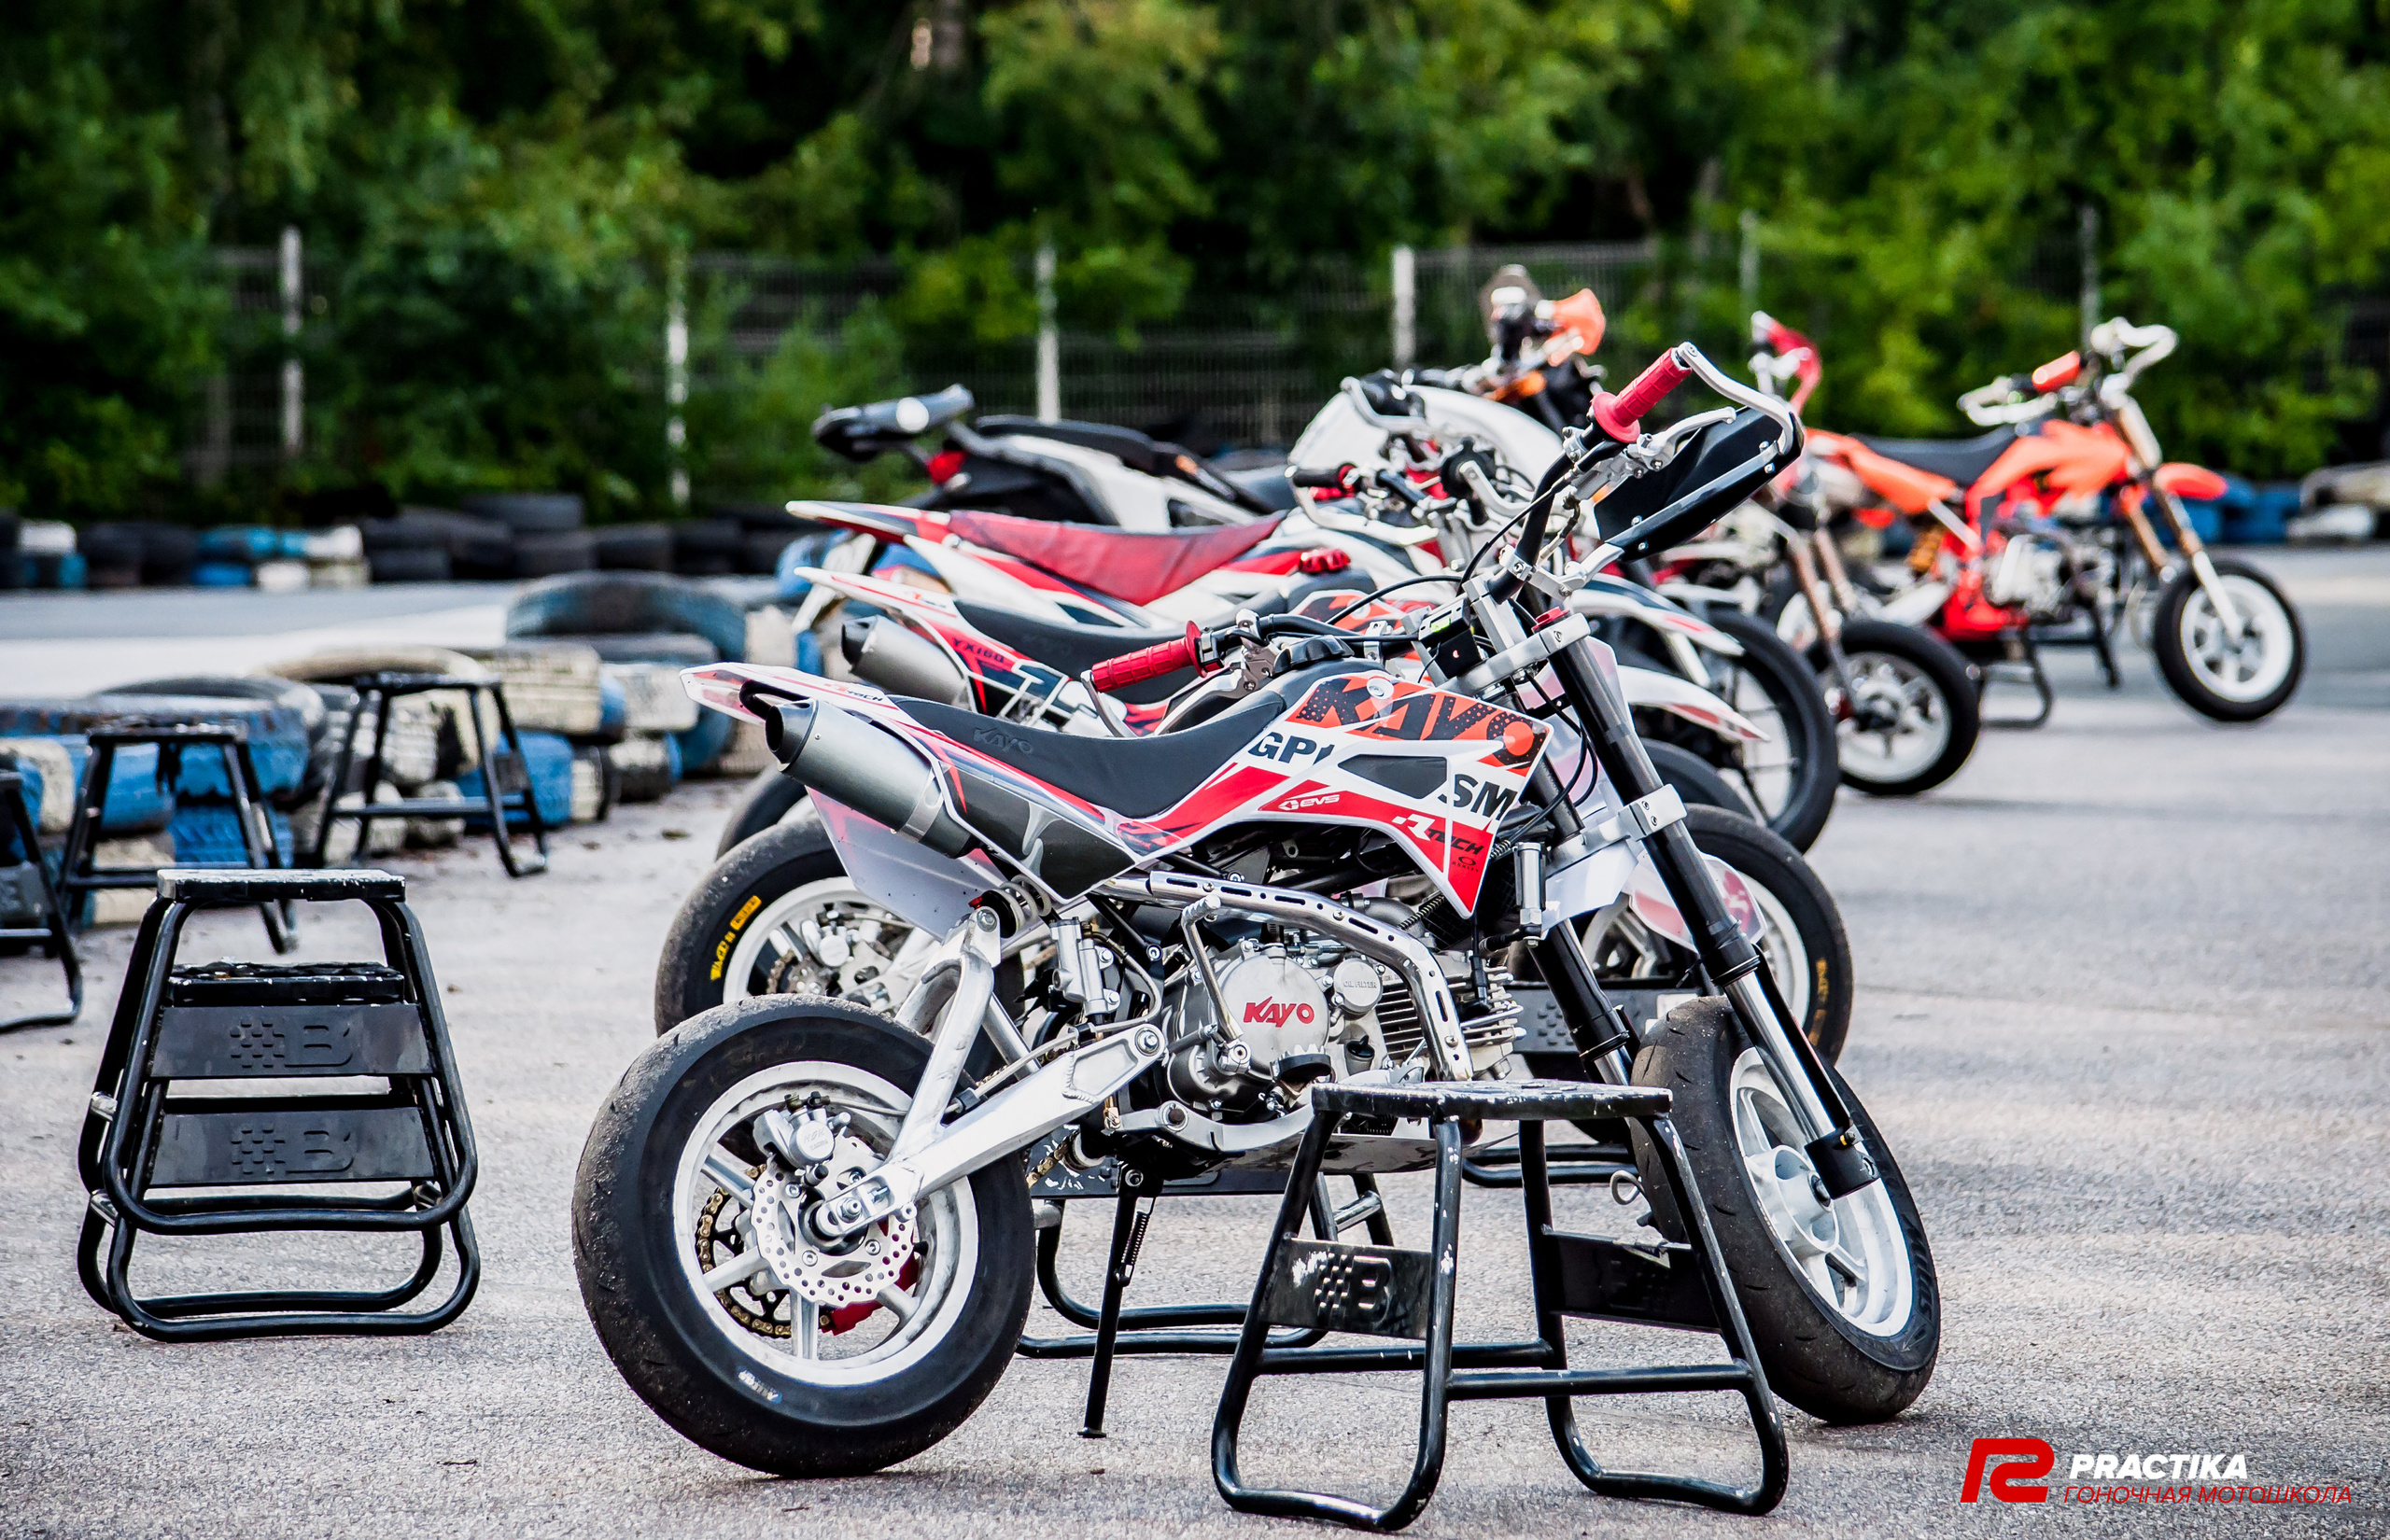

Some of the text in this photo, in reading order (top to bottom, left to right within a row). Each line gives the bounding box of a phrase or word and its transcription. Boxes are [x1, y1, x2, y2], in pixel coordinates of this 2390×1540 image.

[973, 727, 1034, 755] KAYO
[1438, 774, 1518, 820] SM
[1244, 996, 1314, 1028] KAYO
